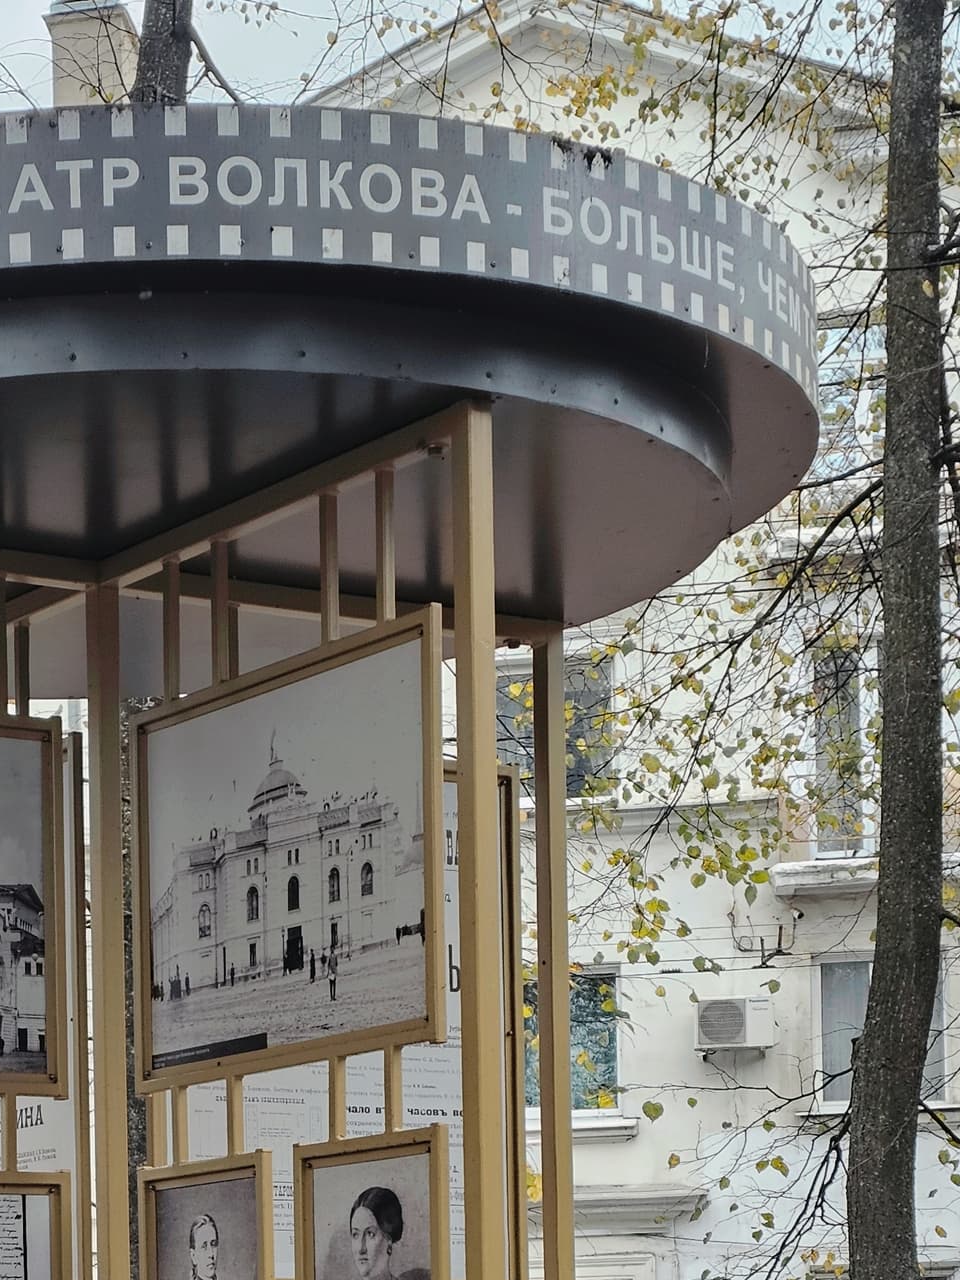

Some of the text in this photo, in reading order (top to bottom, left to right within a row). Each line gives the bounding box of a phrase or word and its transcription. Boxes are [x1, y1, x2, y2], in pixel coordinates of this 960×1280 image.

[168, 155, 491, 224] ВОЛКОВА
[543, 186, 745, 305] БОЛЬШЕ,
[758, 261, 802, 337] ЧЕМ
